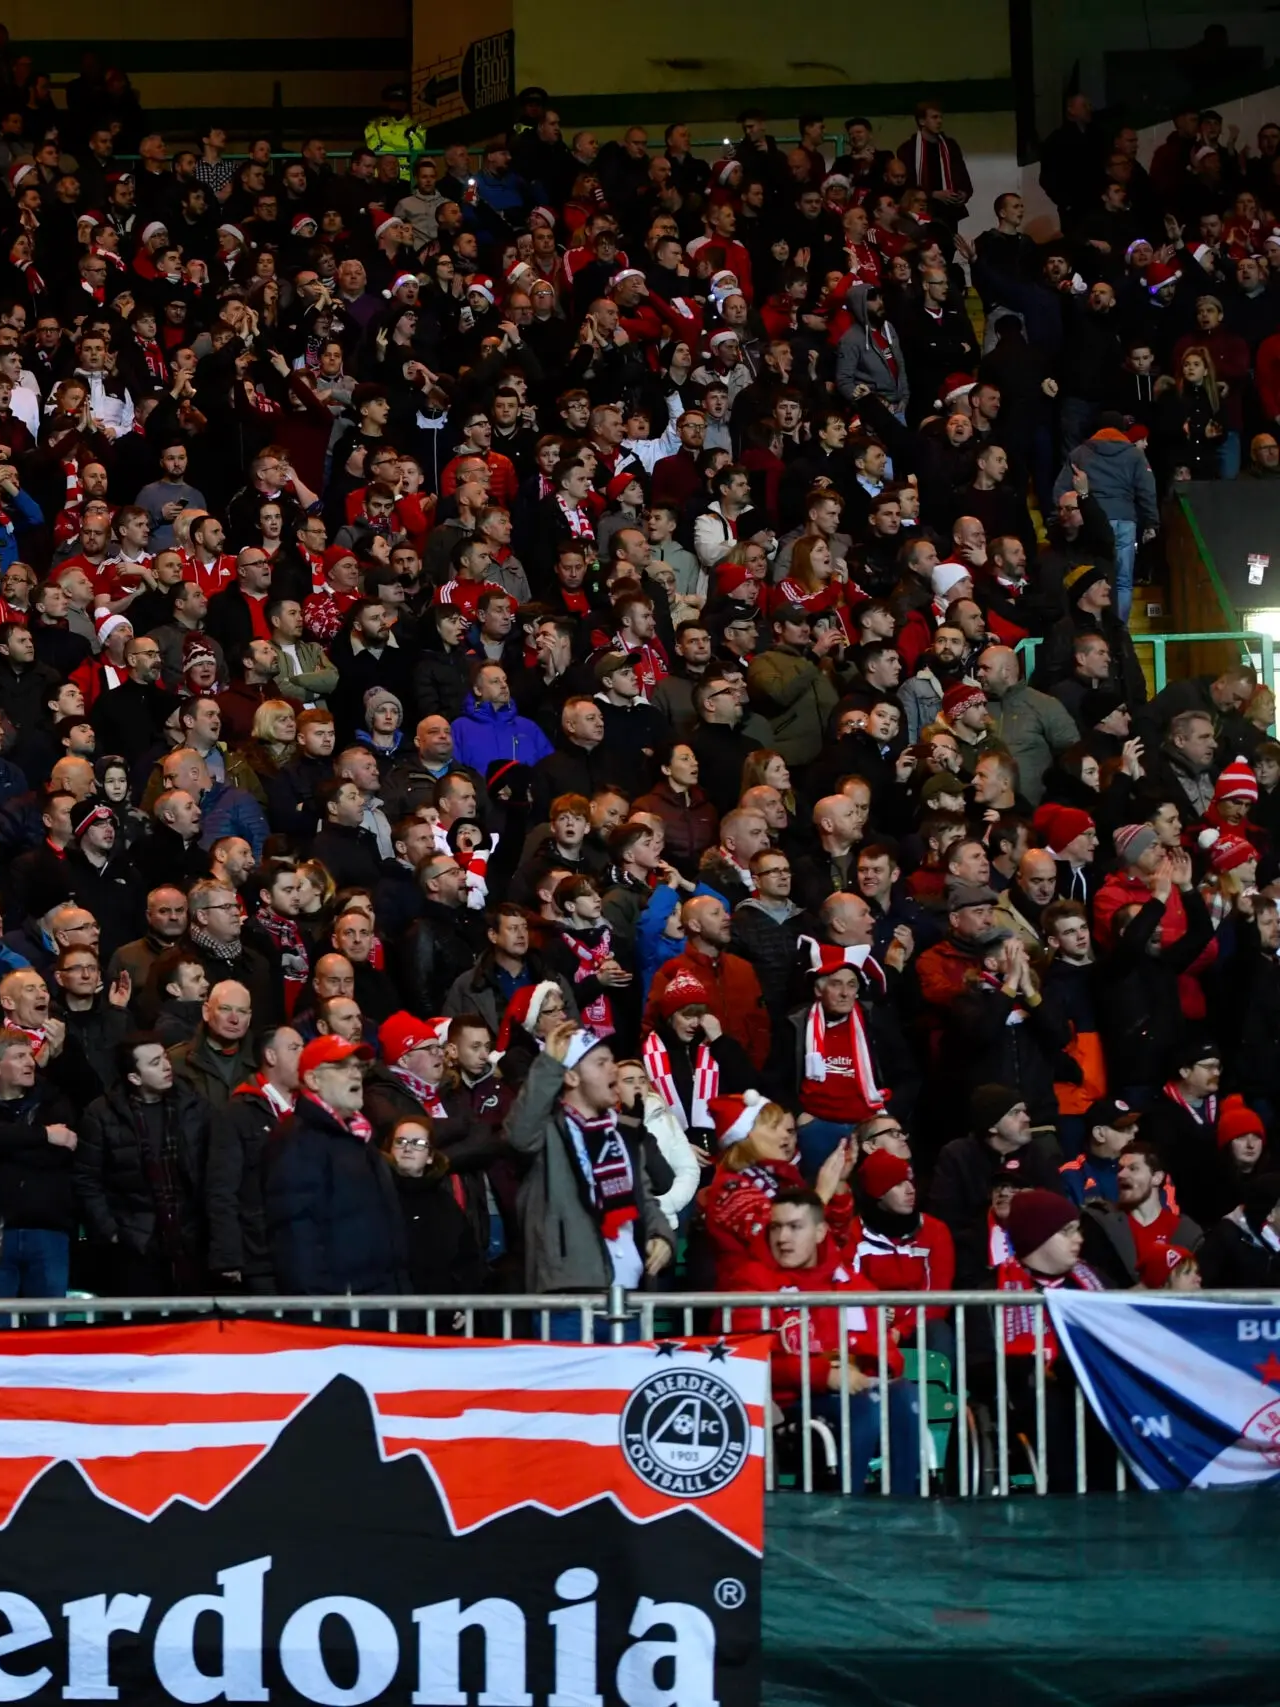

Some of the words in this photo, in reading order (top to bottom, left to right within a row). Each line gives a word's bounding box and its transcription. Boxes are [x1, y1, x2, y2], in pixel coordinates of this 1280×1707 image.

[474, 33, 510, 63] CELTIC
[474, 57, 510, 92] FOOD
[826, 1055, 853, 1065] Saltir
[643, 1375, 735, 1411] ABERDEEN
[626, 1433, 707, 1491] FOOTBALL
[708, 1441, 742, 1482] CLUB
[670, 1450, 699, 1462] 1903
